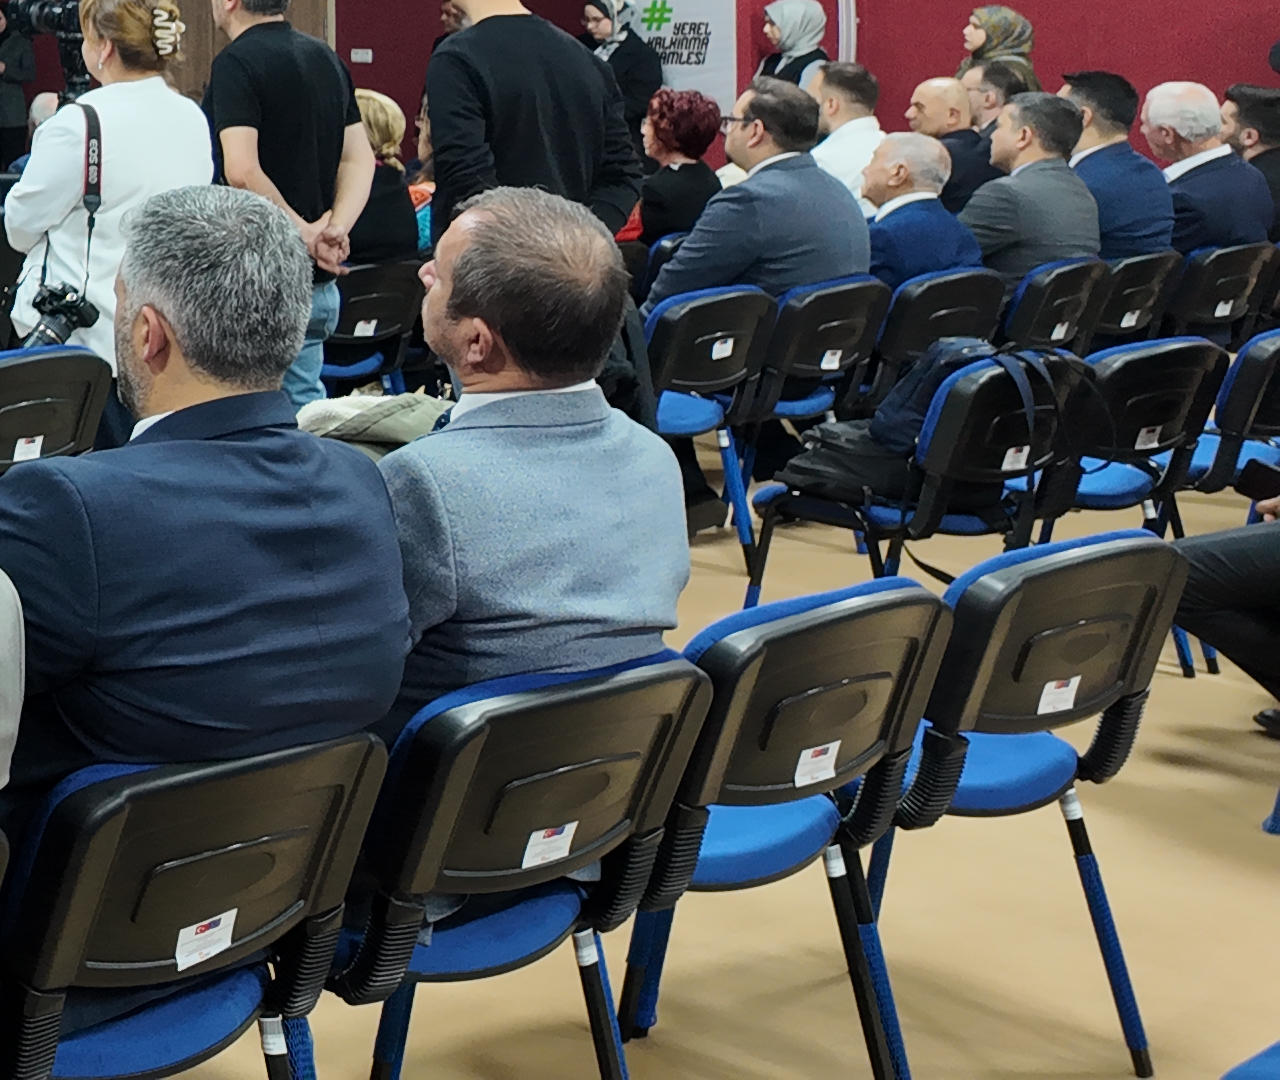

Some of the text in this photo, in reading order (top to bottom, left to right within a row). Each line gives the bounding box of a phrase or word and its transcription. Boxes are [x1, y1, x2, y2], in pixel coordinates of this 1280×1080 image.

[673, 22, 712, 36] YEREL
[659, 51, 707, 65] AMLESİ
[88, 139, 98, 165] EOS
